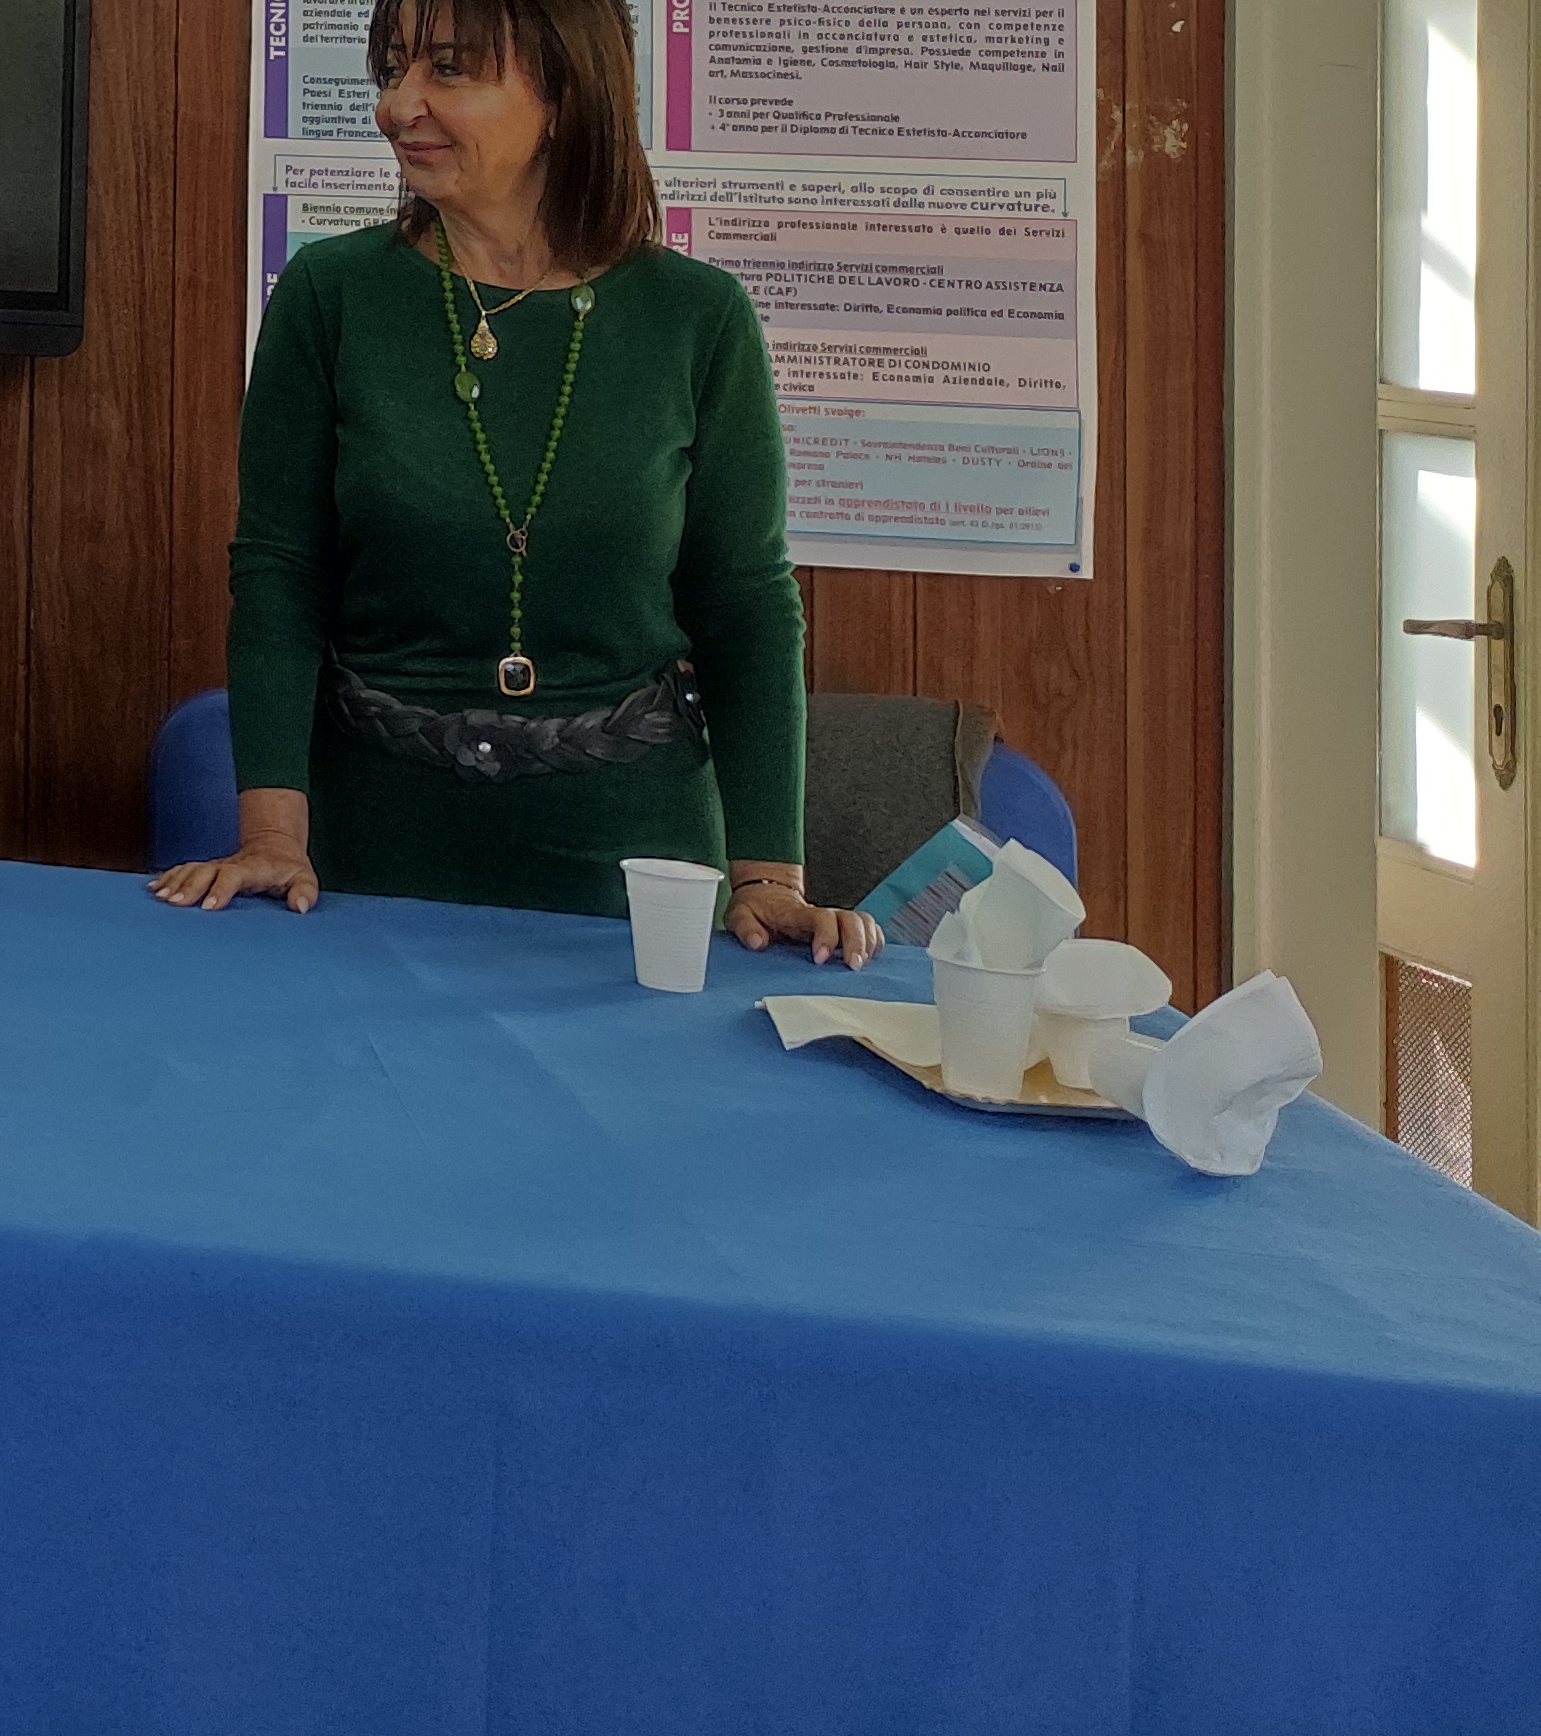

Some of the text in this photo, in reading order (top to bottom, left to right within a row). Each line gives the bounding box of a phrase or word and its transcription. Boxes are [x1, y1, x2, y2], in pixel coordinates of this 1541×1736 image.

[285, 164, 390, 180] Per potenziare le
[765, 272, 1064, 293] POLITICHE DEL LAVORO CENTRO ASSISTENZA
[763, 285, 798, 298] (CAF)
[902, 359, 992, 373] CONDOMINIO
